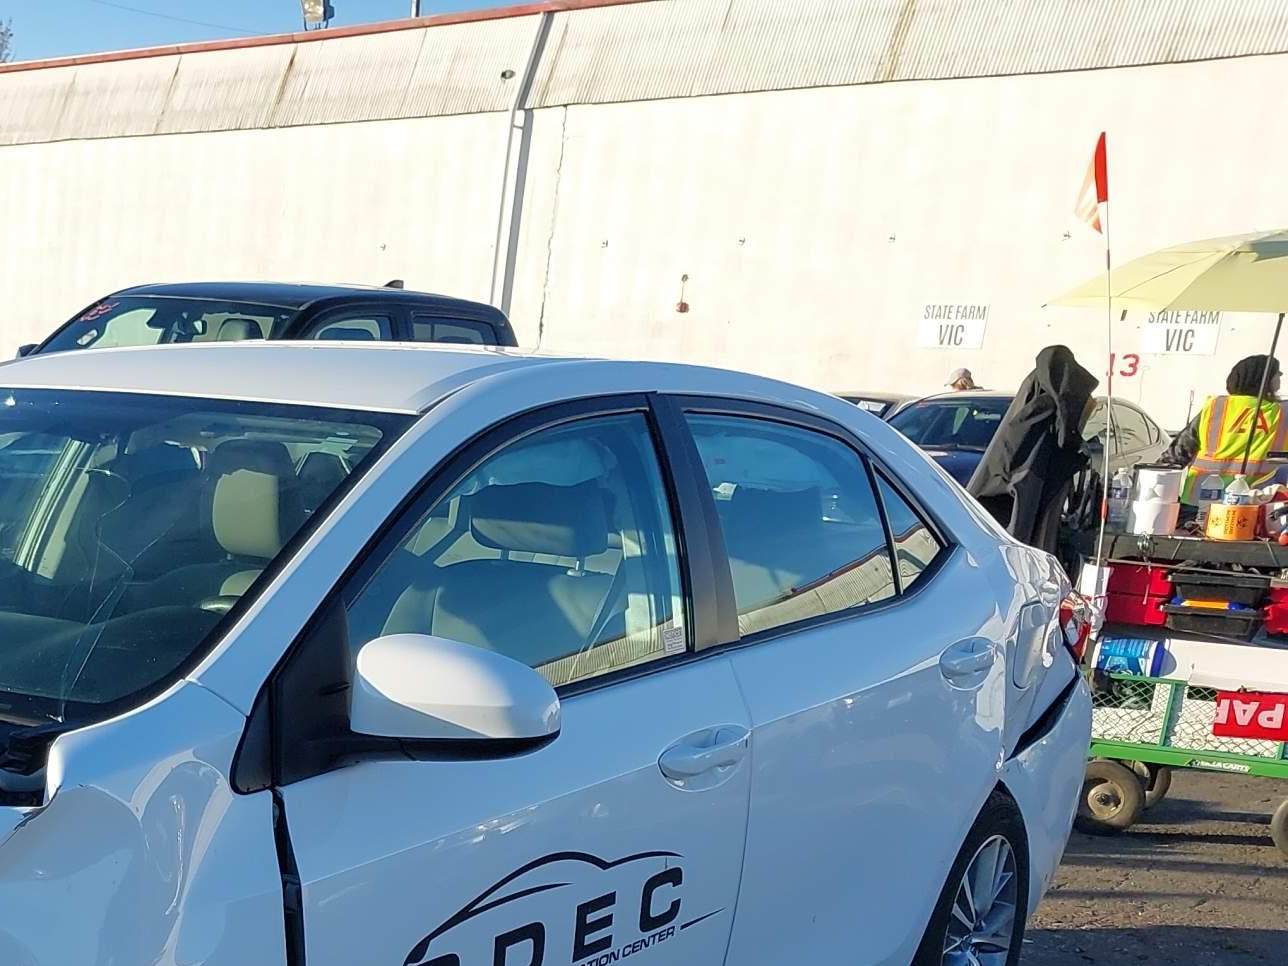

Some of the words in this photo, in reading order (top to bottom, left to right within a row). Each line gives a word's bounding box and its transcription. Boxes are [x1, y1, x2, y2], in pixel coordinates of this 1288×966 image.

[924, 304, 954, 320] STATE
[955, 304, 987, 320] FARM
[1184, 311, 1220, 325] FARM
[939, 324, 965, 346] VIC
[1165, 329, 1195, 352] VIC
[1109, 353, 1140, 377] 13
[621, 925, 676, 959] CENTER
